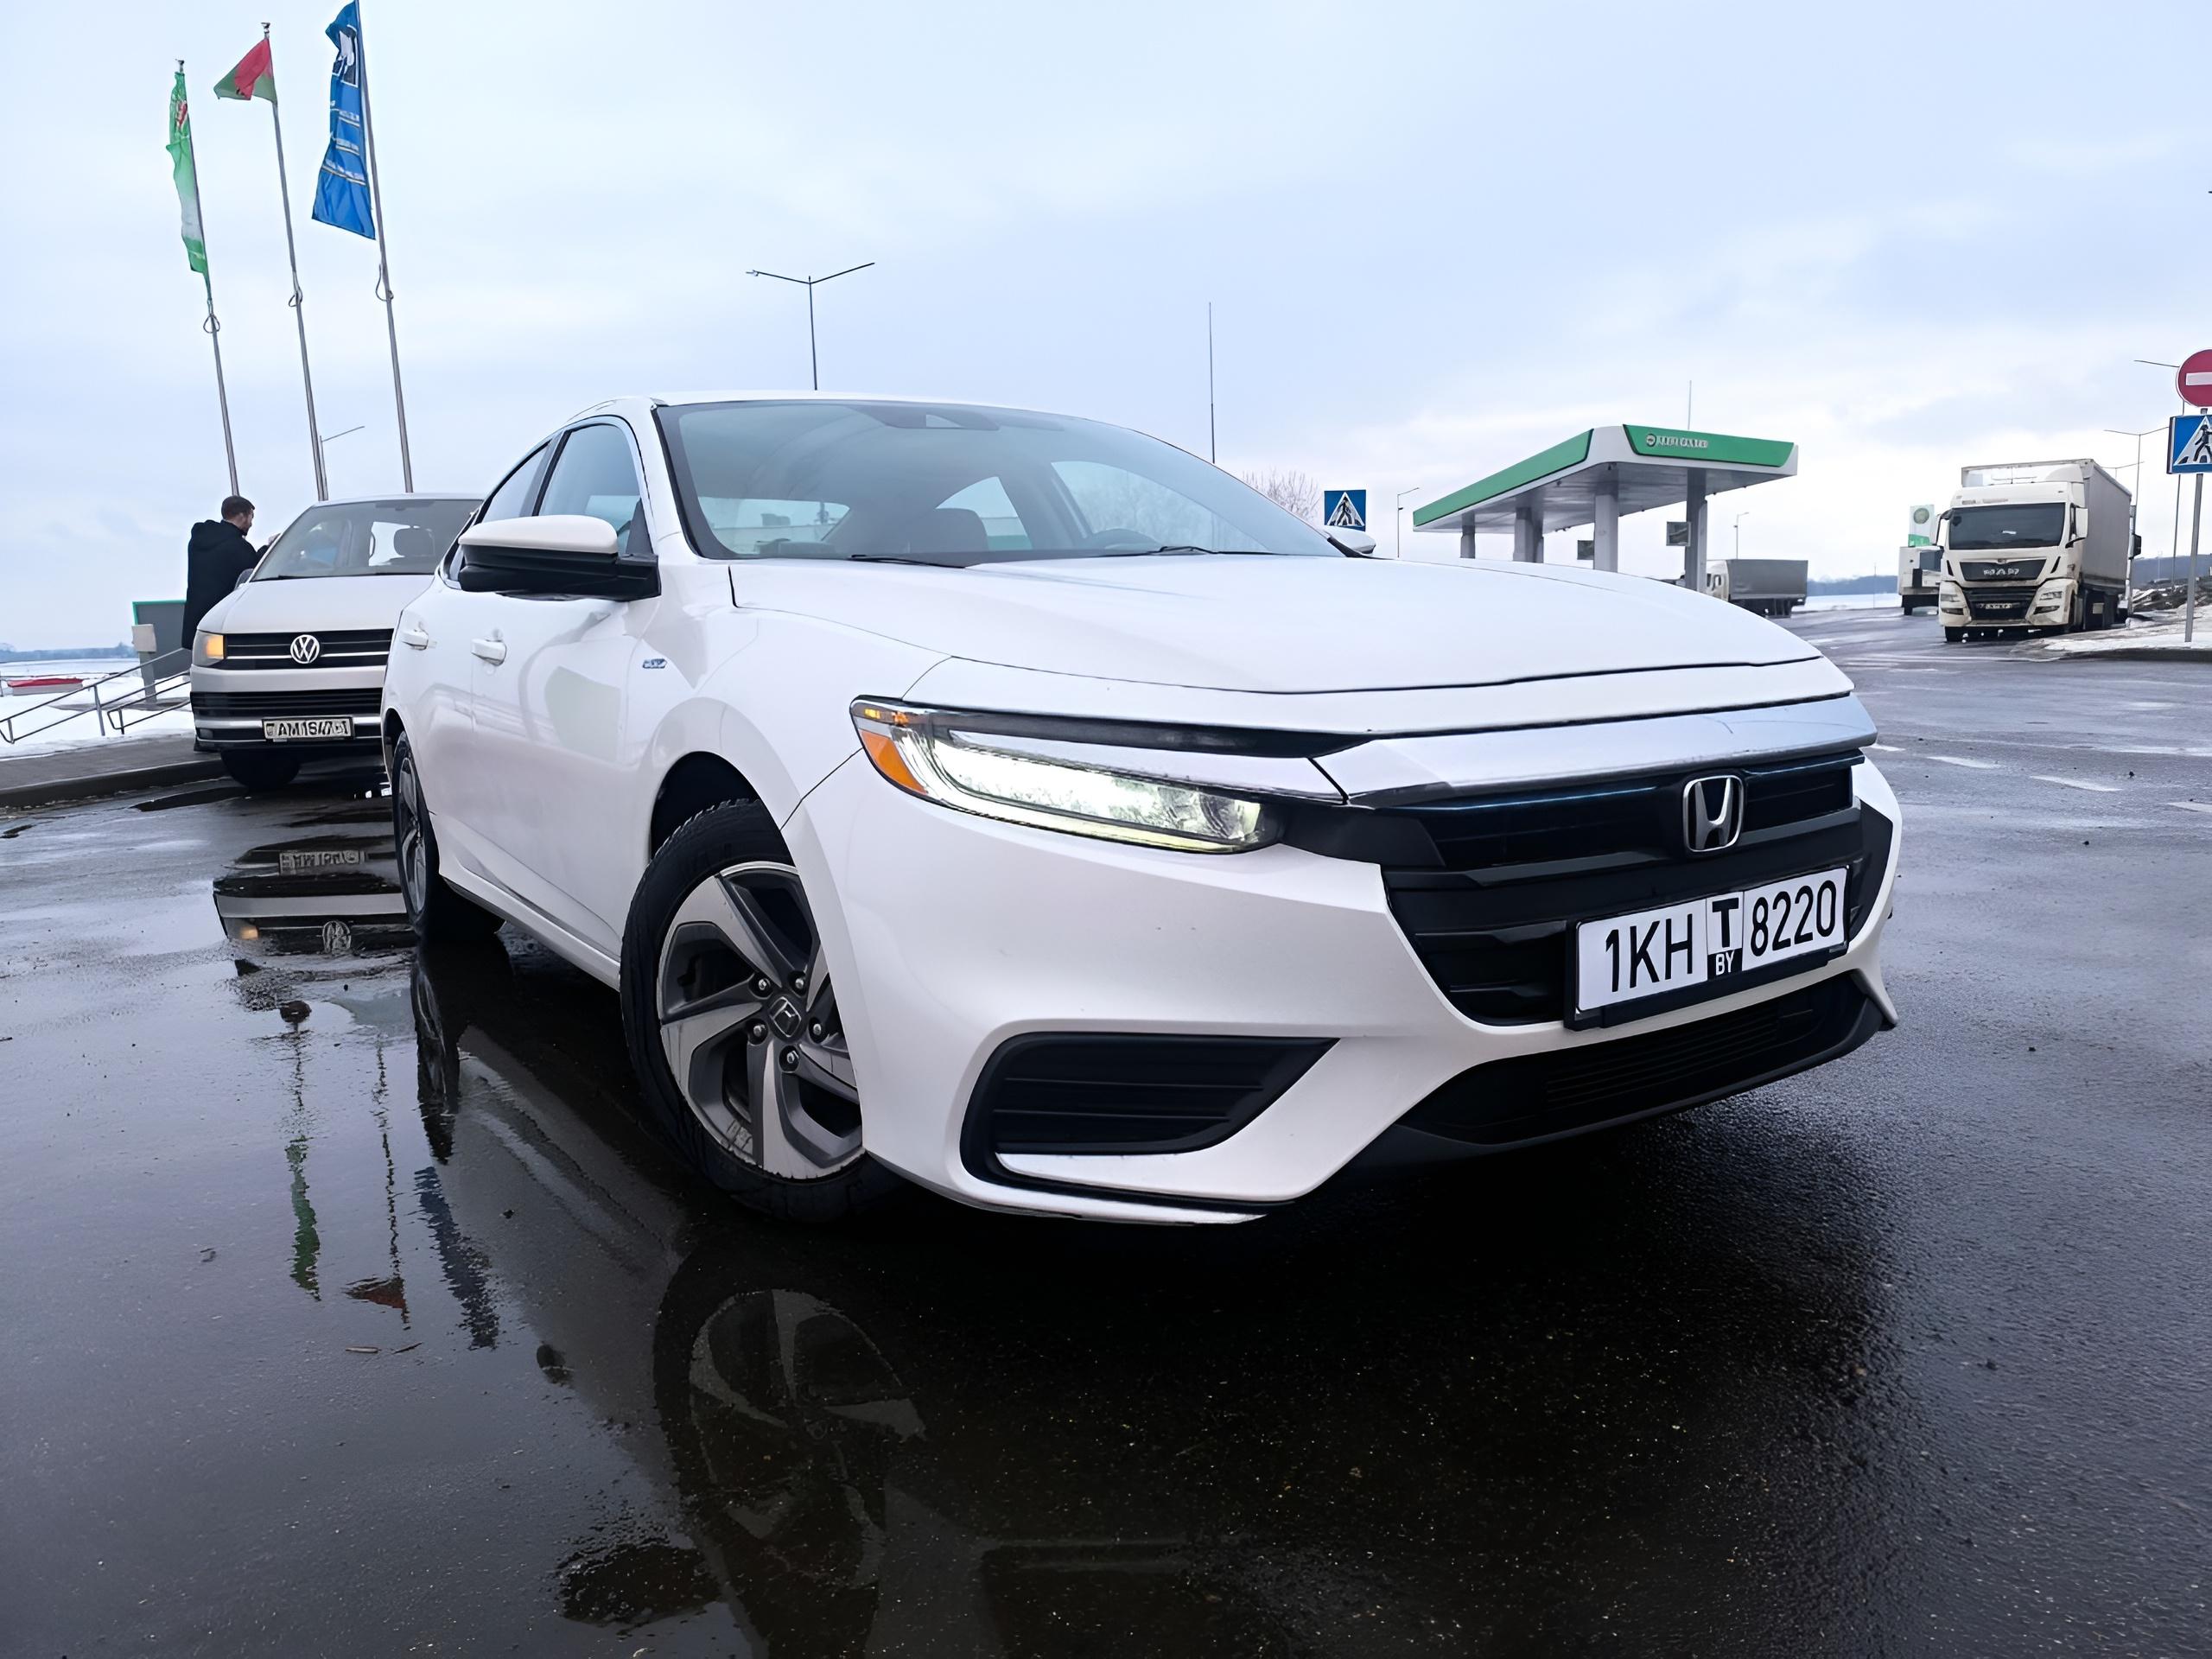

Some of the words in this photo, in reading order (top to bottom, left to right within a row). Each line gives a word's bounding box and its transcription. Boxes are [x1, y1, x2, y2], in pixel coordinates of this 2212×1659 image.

[1605, 913, 1693, 993] 1KH
[1712, 897, 1739, 948] T
[1751, 880, 1837, 957] 8220
[1715, 950, 1734, 976] BY
